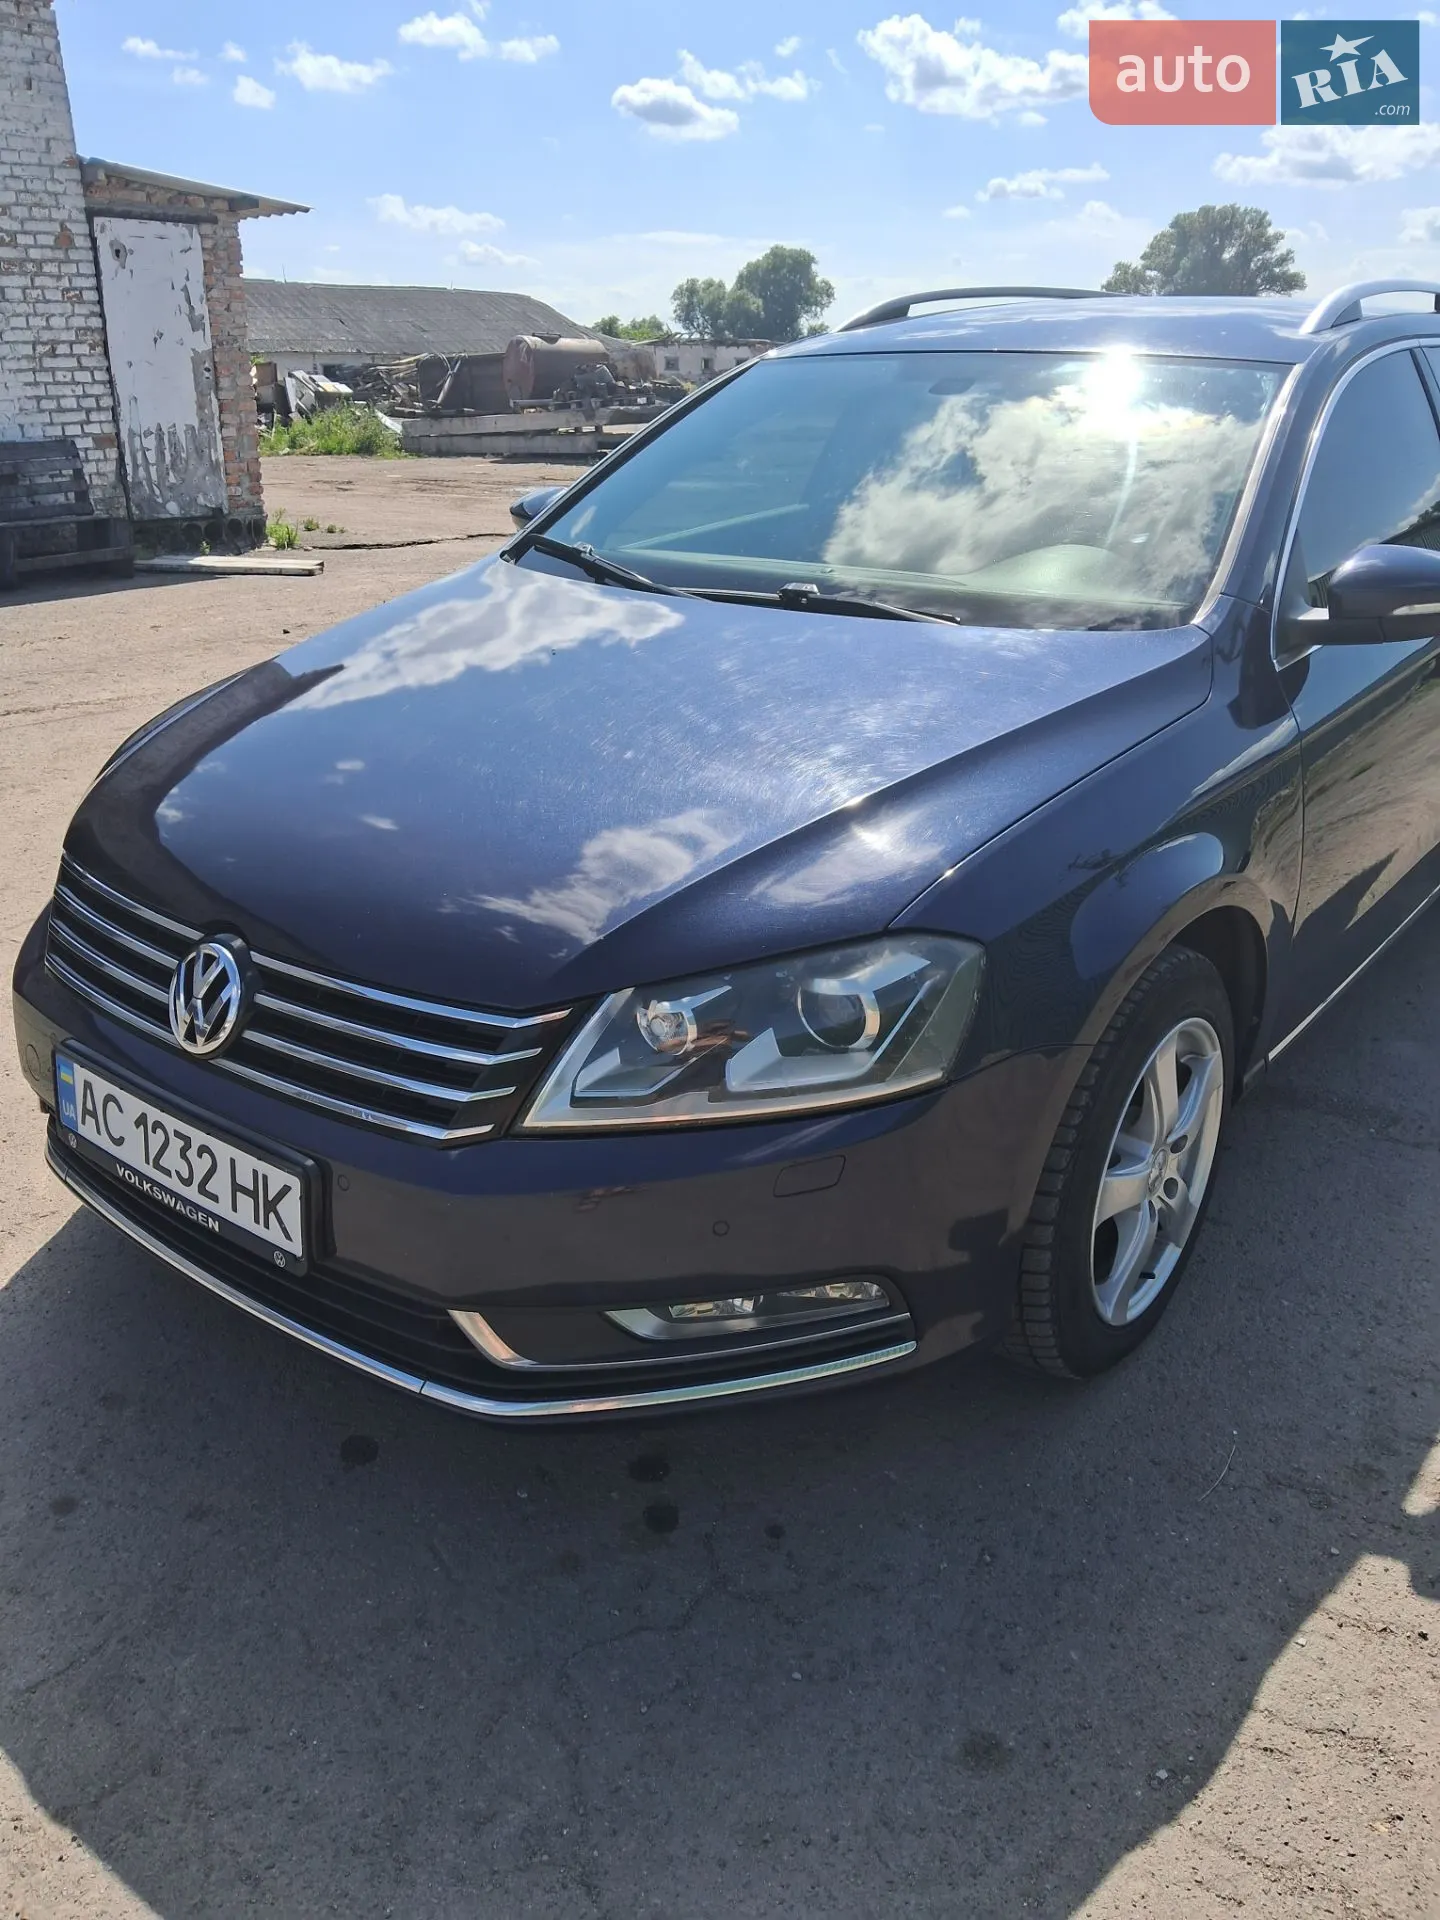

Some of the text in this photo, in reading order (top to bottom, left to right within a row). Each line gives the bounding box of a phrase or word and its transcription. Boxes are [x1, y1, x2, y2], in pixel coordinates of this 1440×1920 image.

[62, 1102, 76, 1121] UA
[80, 1079, 293, 1242] AC 1232 HK
[116, 1163, 220, 1233] VOLKSWAGEN
